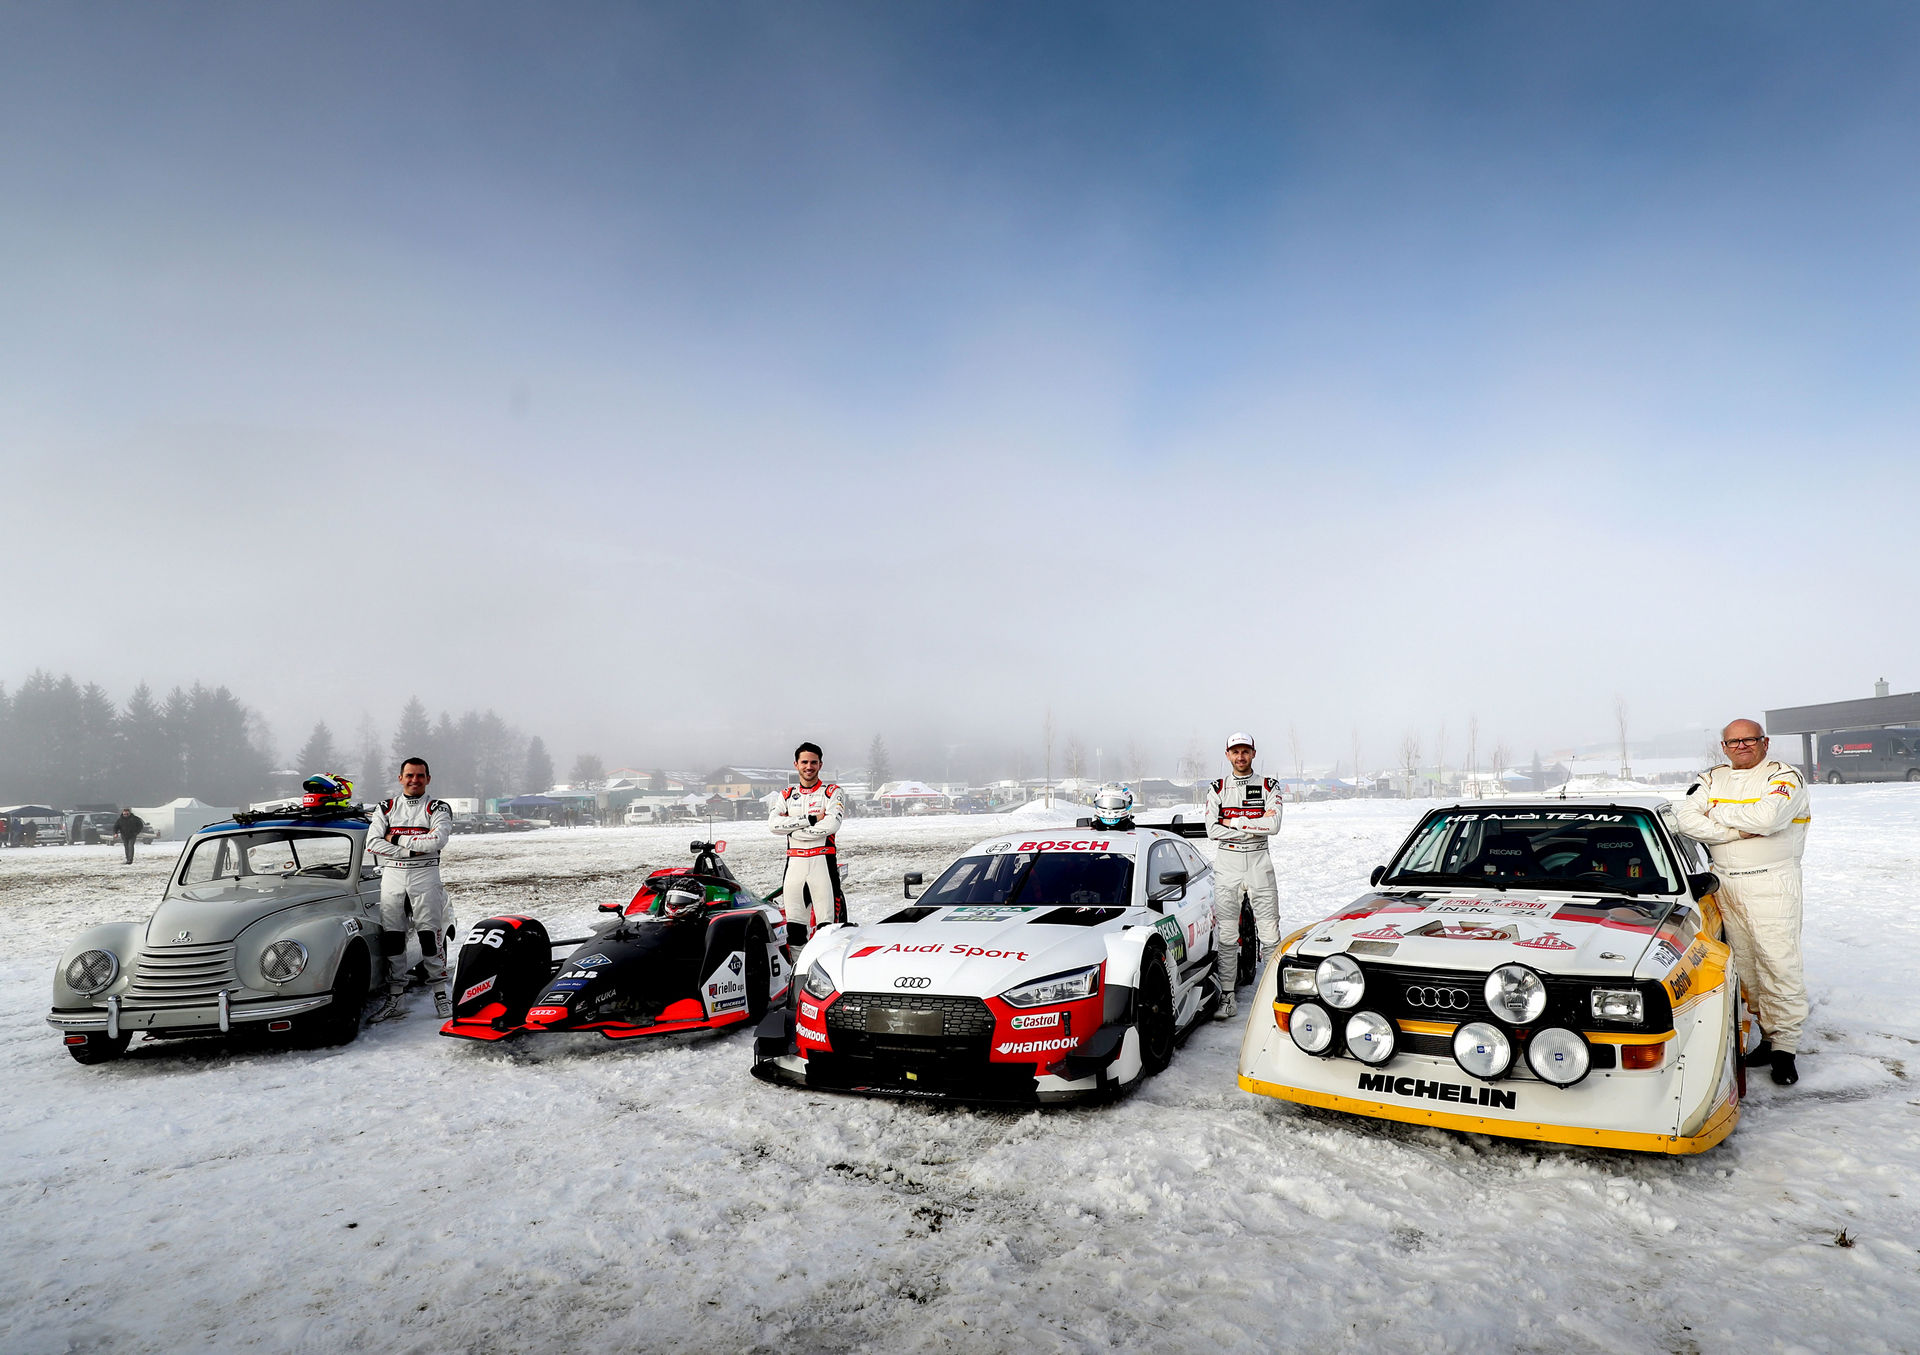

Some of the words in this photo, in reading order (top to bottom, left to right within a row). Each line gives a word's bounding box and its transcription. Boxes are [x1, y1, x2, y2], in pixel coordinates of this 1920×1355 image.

[1444, 814, 1480, 823] HB
[1545, 813, 1624, 822] TEAM
[1017, 841, 1110, 851] BOSCH
[1489, 848, 1522, 856] RECARO
[1596, 841, 1634, 849] RECARO
[1157, 919, 1181, 940] DEKRA
[883, 943, 945, 953] Audi
[950, 944, 1029, 961] Sport
[1171, 944, 1184, 961] DTM
[771, 955, 781, 977] 6
[557, 970, 598, 979] ABB
[466, 980, 491, 998] SONAX
[718, 981, 737, 995] riello
[1670, 967, 1693, 1001] Castrol
[595, 988, 617, 1003] KUKA
[1023, 1014, 1057, 1027] Castrol
[1012, 1036, 1080, 1054] Hankook
[905, 1089, 947, 1097] Sport
[1357, 1072, 1517, 1110] MICHELIN
